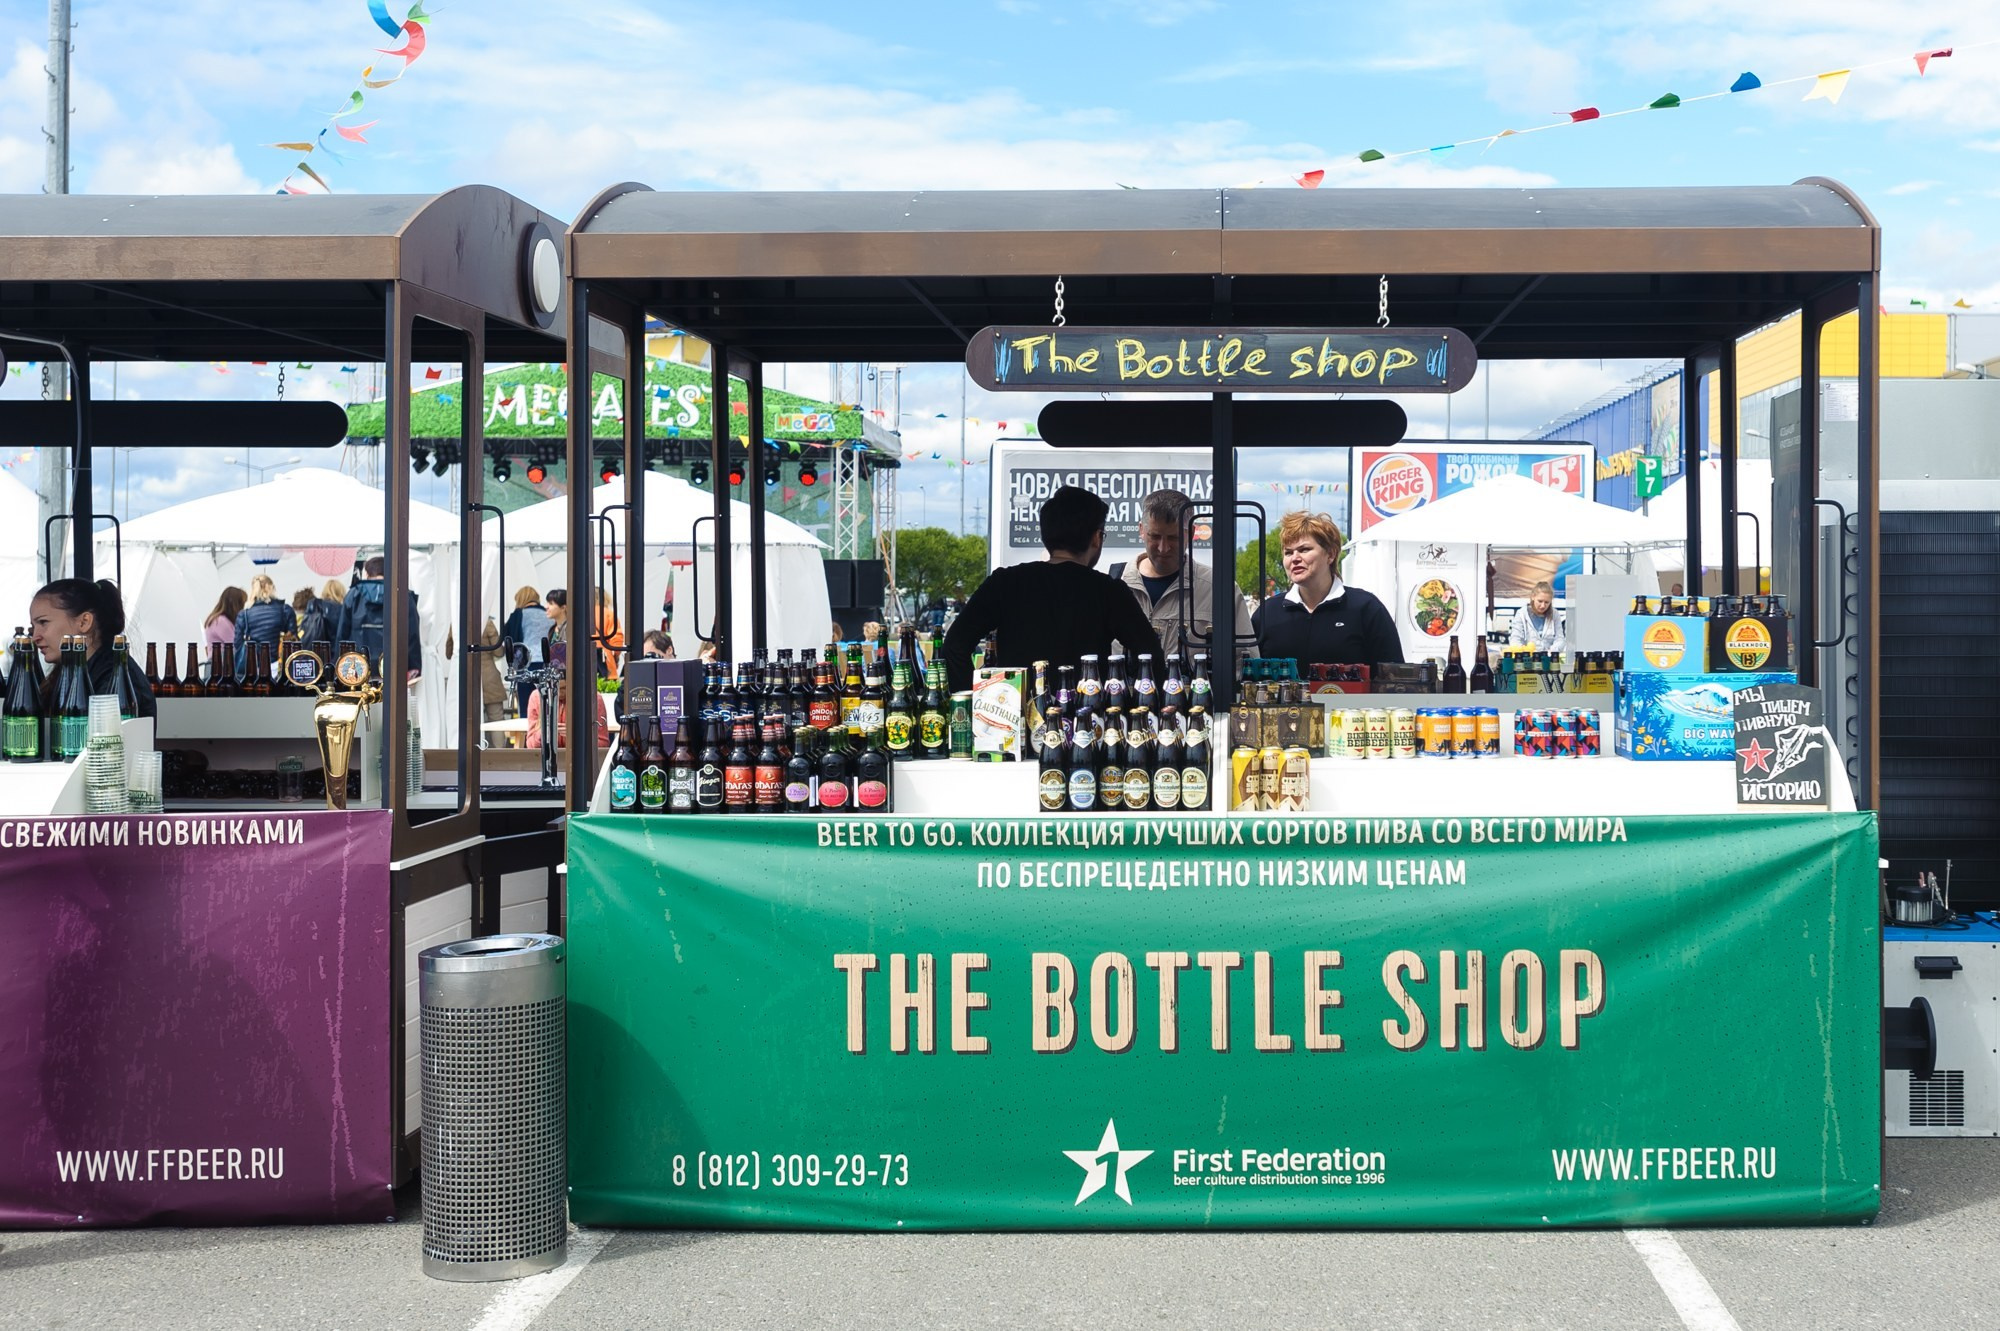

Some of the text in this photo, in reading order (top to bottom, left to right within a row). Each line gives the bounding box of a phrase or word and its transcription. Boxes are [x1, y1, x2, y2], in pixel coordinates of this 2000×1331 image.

[1012, 333, 1419, 384] The Bottle shop
[1446, 454, 1520, 464] ТВОЙ ЛЮБИМЫЙ
[1645, 458, 1657, 476] P
[1373, 467, 1422, 490] BURGER
[1645, 477, 1655, 494] 7
[1375, 478, 1424, 506] KING
[1734, 686, 1766, 706] МЫ
[1760, 699, 1811, 716] ПИШЕМ
[809, 708, 833, 716] LONDON
[974, 698, 1020, 726] CLAUSTHALER
[1684, 728, 1735, 739] BIG WAV
[698, 776, 720, 786] Ginger
[1740, 780, 1821, 801] ИСТОРИЮ
[0, 819, 304, 848] СВЕЖИМИ НОВИНКАМИ
[817, 817, 1628, 849] BEER TO GO. КОЛЛЕКЦИЯ ЛУЧШИХ СОРТОВ ПИВА СО ВСЕГО МИРА
[977, 859, 1466, 891] ПО БЕСПРЕЦЕДЕНТНО НИЗКИМ ЦЕНАМ
[833, 947, 1603, 1054] THE BOTTLE SHOP
[56, 1147, 284, 1183] WWW.FFBEER.RU
[673, 1151, 909, 1190] 8 (812) 309-29-73
[1173, 1147, 1386, 1172] First Federation
[1551, 1146, 1777, 1181] WWW.FFBEER.RU
[1173, 1172, 1385, 1186] beer culture distribution since 1996
